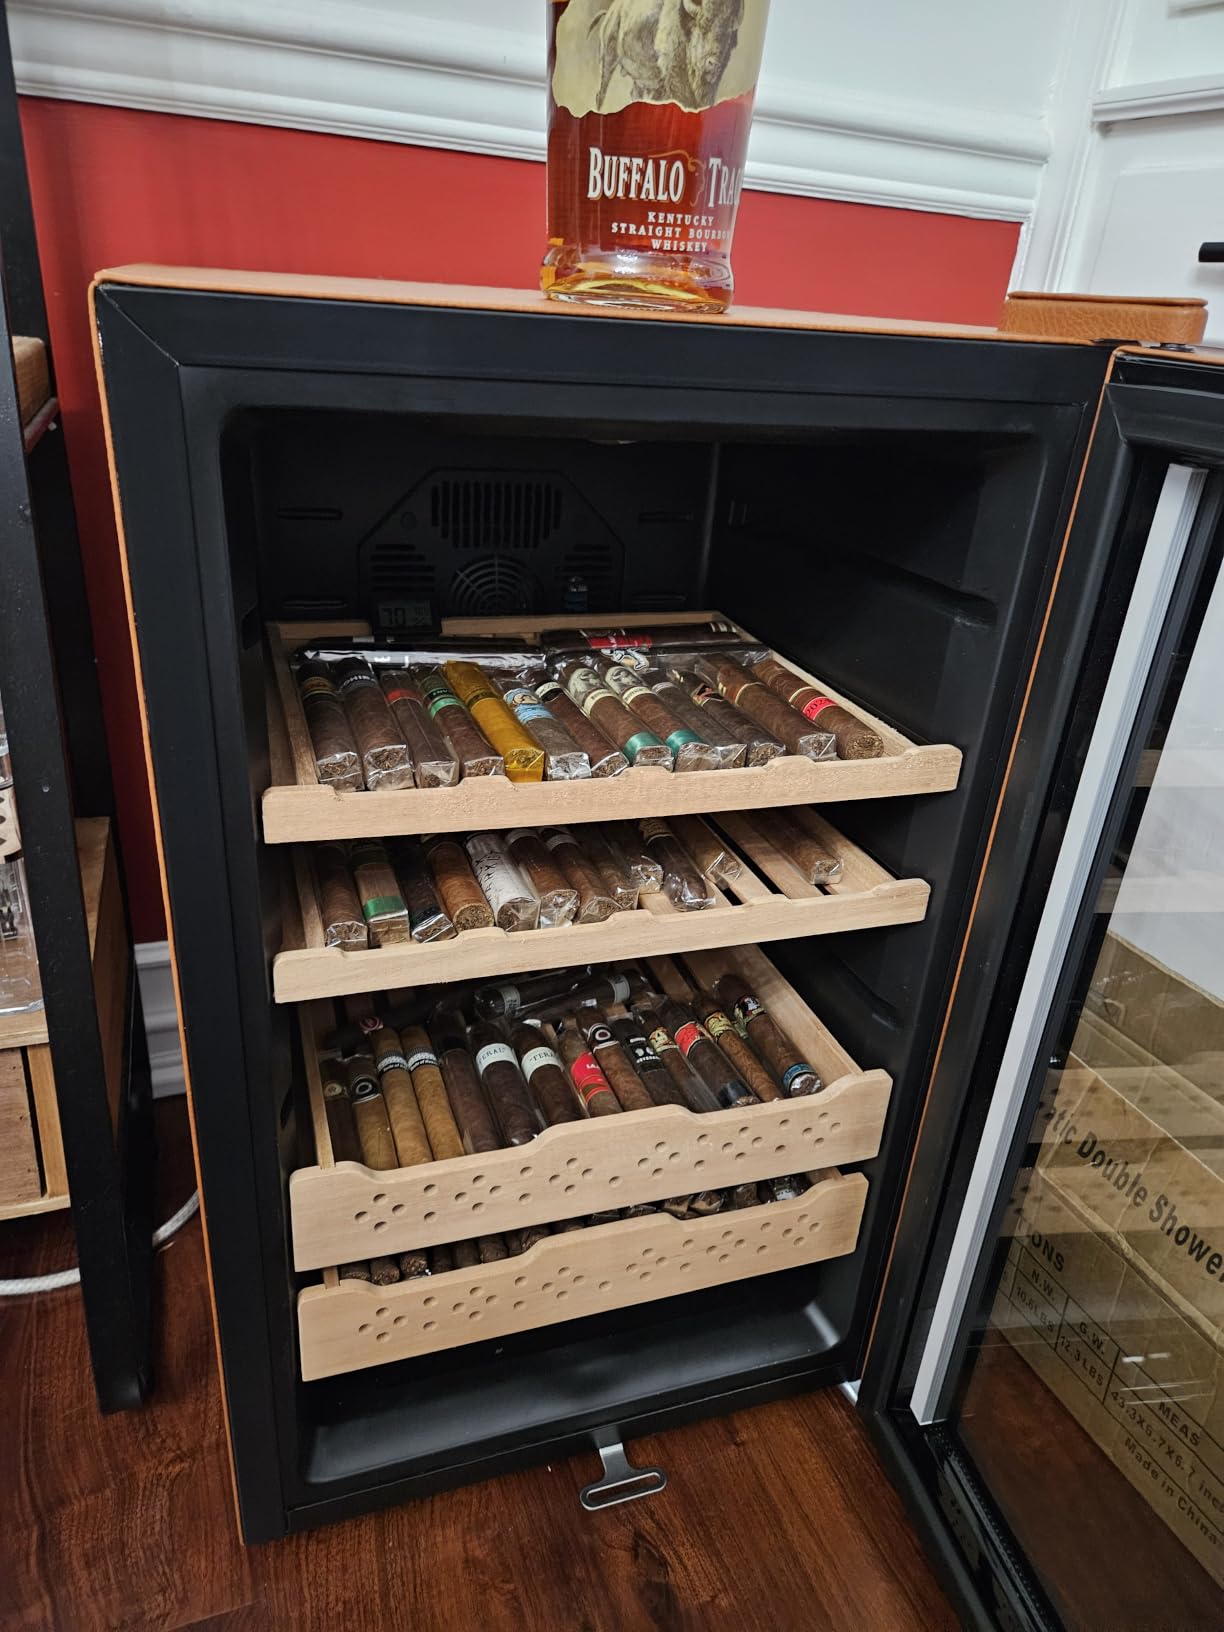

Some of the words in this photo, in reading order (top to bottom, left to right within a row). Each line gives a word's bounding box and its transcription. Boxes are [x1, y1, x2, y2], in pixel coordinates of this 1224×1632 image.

[587, 146, 685, 203] BUFFALO
[611, 222, 682, 238] STRAIGHT
[648, 211, 714, 226] KENTUCKY
[651, 239, 708, 252] WHISKEY
[1076, 1130, 1148, 1208] Double
[1158, 1401, 1201, 1447] MEAS
[1124, 1436, 1160, 1481] Made
[1160, 1479, 1175, 1497] in
[1177, 1496, 1219, 1546] China
